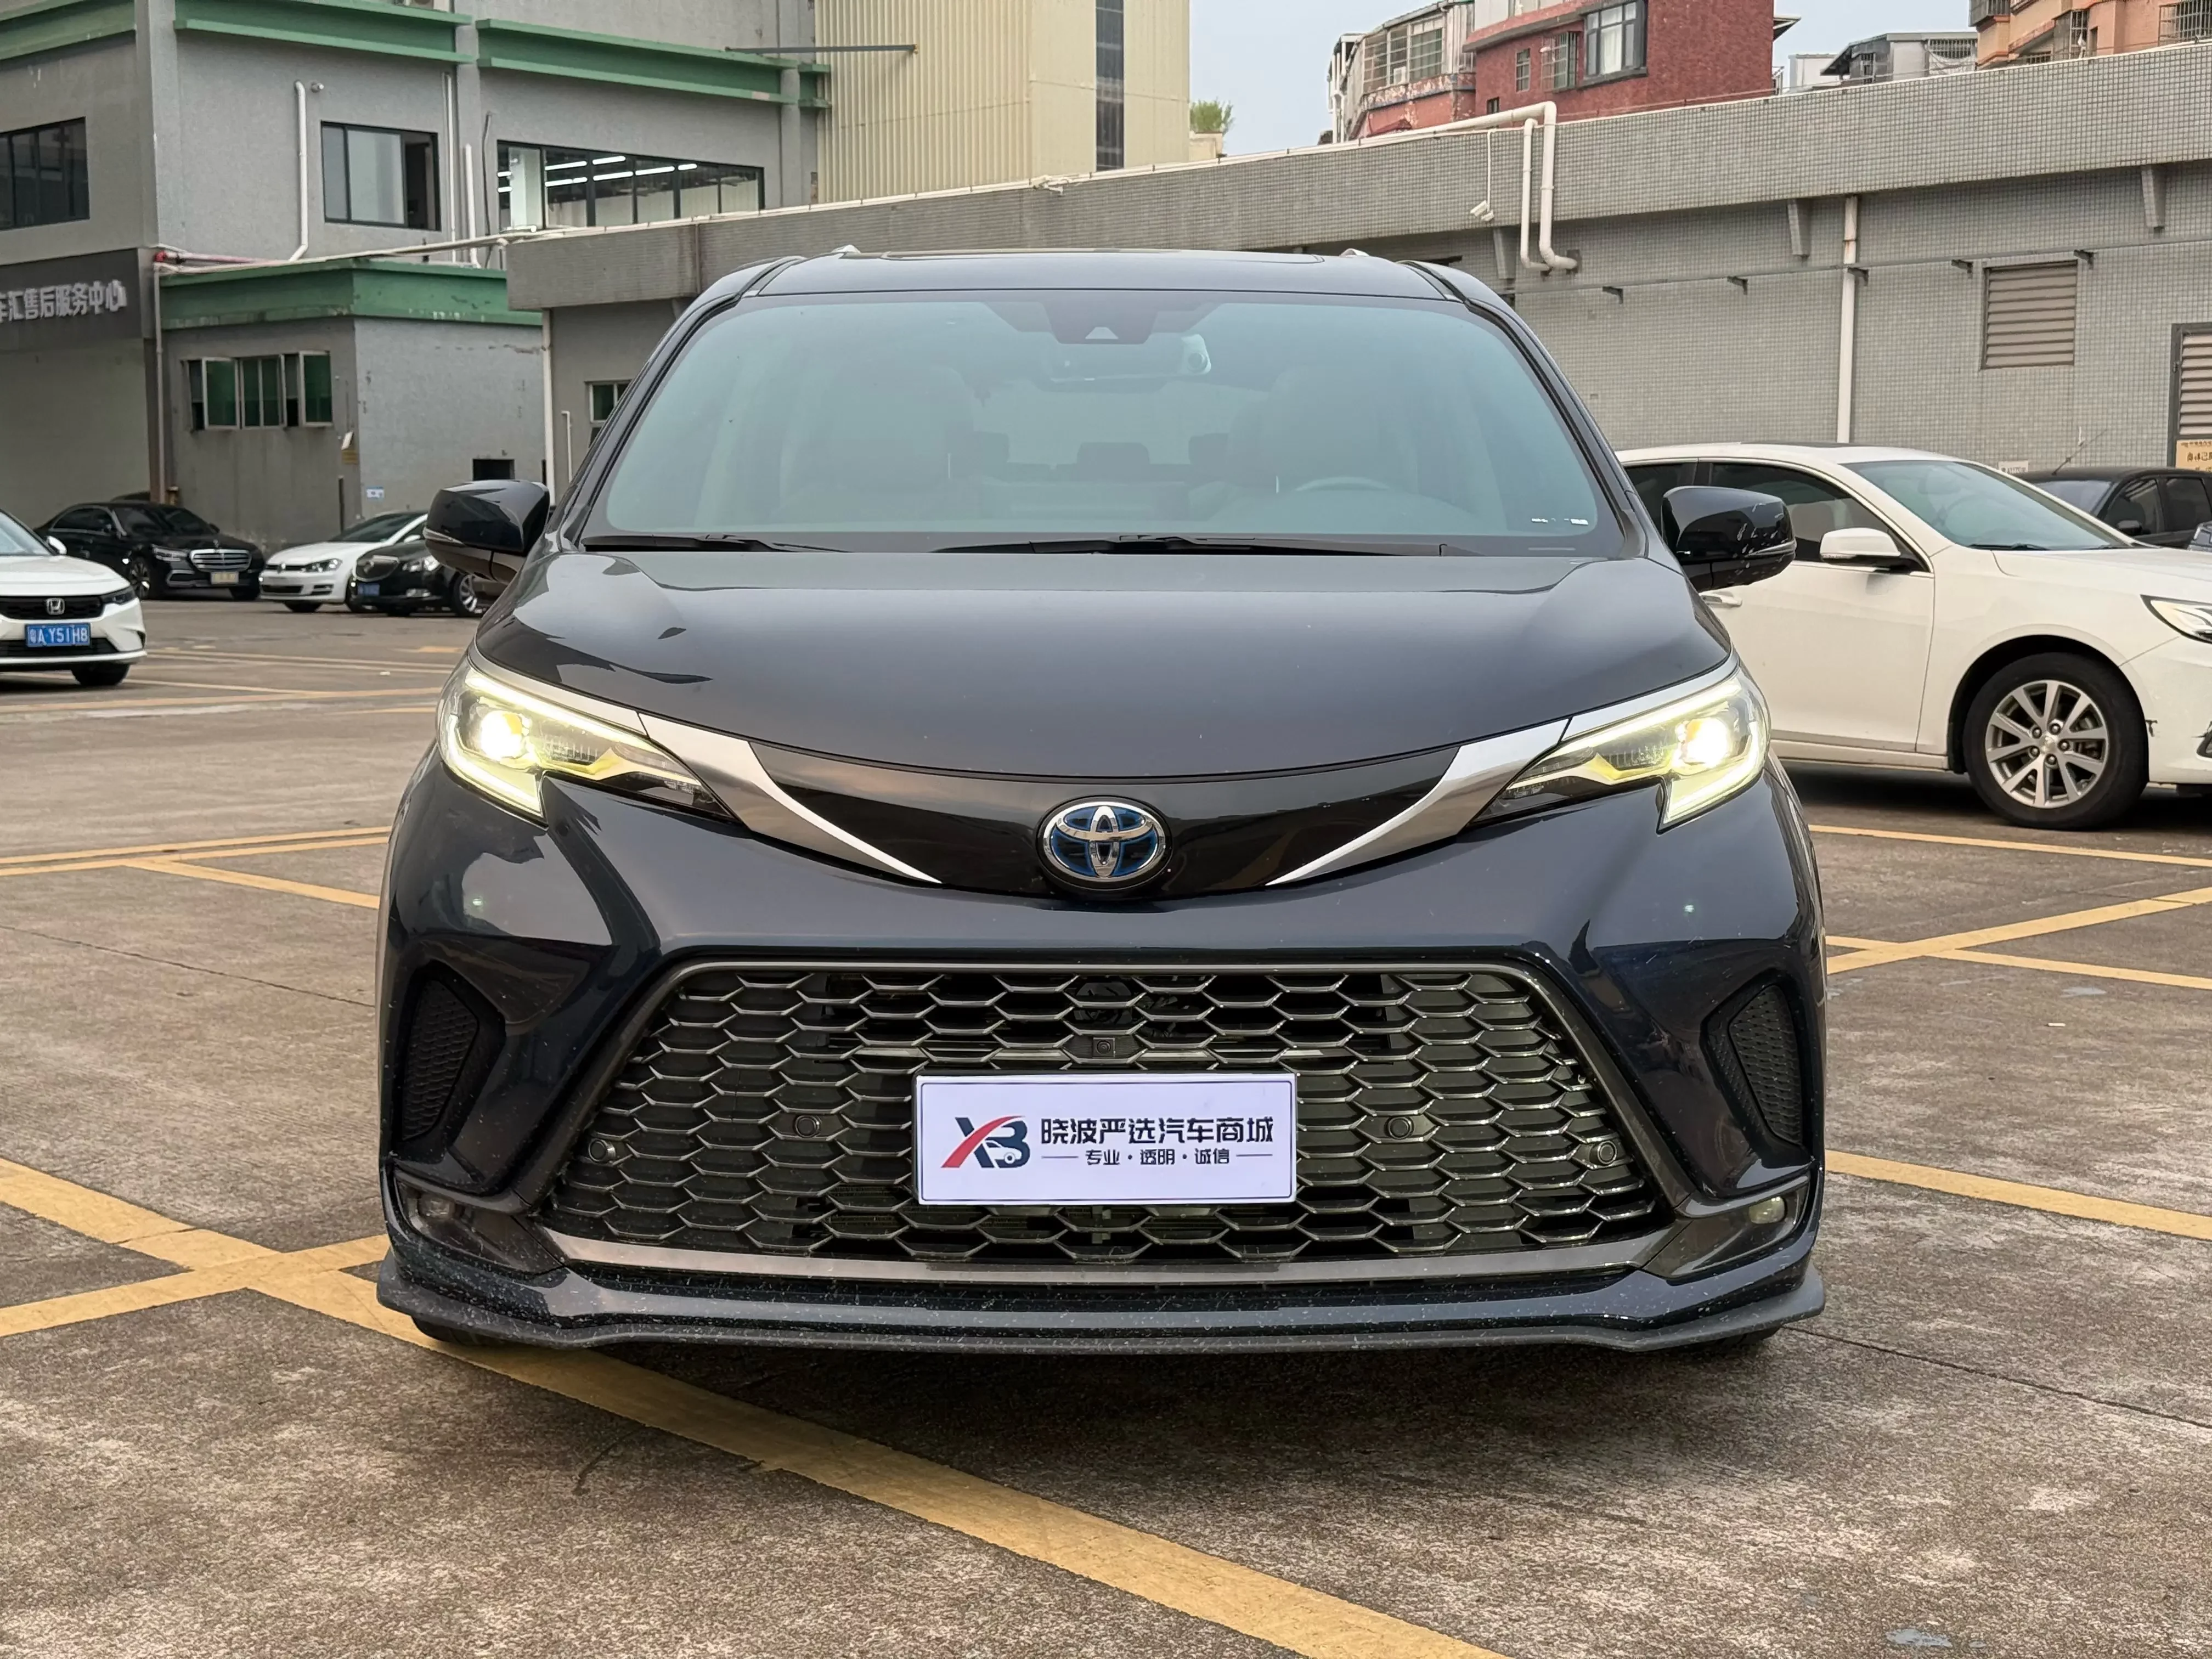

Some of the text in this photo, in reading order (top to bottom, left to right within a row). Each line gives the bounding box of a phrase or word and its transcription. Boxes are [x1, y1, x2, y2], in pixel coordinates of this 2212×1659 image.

[1041, 1117, 1273, 1144] 晓波严选汽车商城
